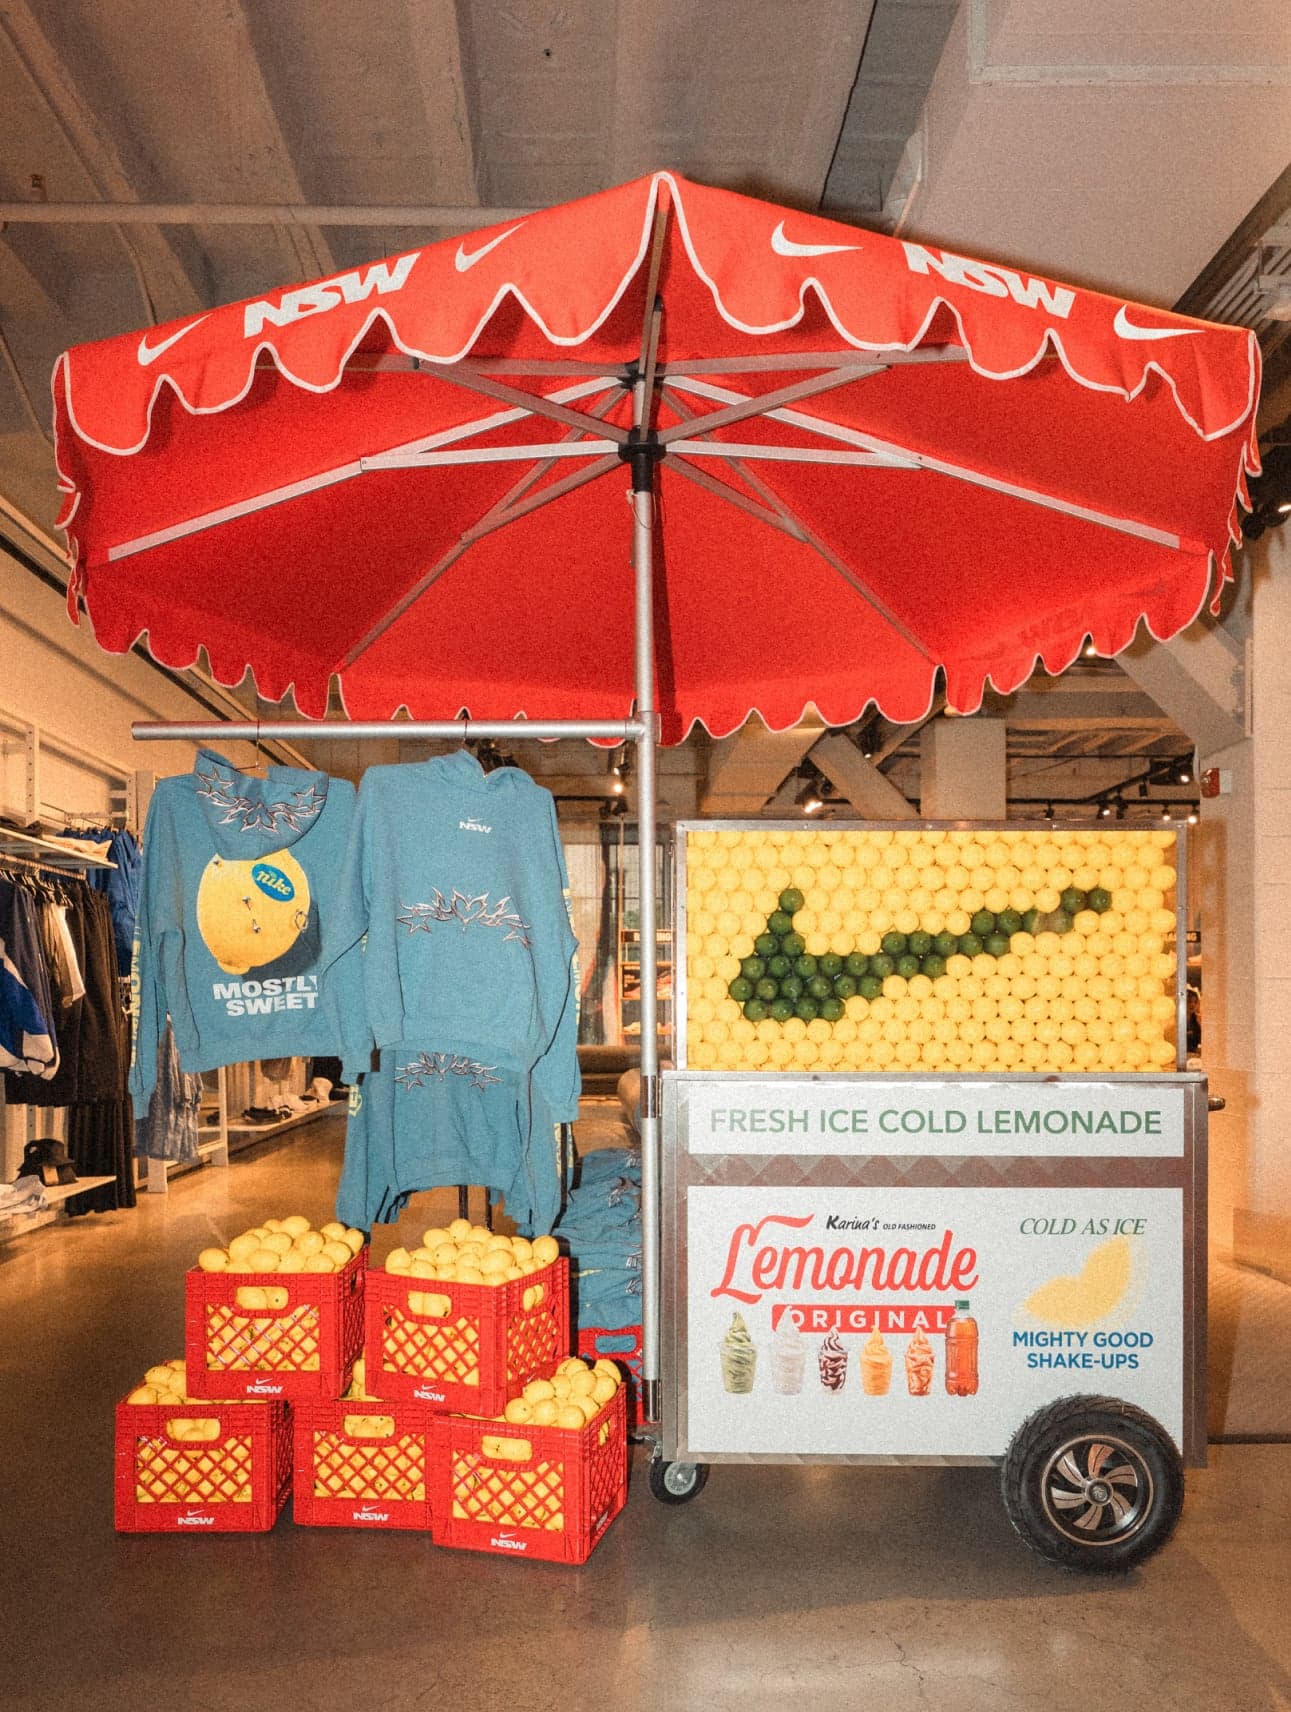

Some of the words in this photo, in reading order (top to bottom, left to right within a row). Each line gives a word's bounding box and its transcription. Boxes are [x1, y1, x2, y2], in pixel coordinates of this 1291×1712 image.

[902, 241, 1077, 320] NSW
[243, 251, 422, 339] NSW
[459, 820, 493, 834] NSW
[226, 992, 319, 1017] SWEET
[710, 1108, 809, 1133] FRESH
[820, 1109, 869, 1133] ICE
[878, 1109, 967, 1134] COLD
[977, 1110, 1163, 1134] LEMONADE
[825, 1214, 880, 1231] Karina's
[882, 1222, 897, 1231] OLD
[897, 1222, 937, 1231] FASHIONED
[1019, 1218, 1077, 1235] COLD
[1081, 1218, 1110, 1235] AS
[1113, 1218, 1148, 1235] ICE
[710, 1213, 980, 1304] Lemonade
[1012, 1331, 1088, 1347] MIGHTY
[1093, 1331, 1154, 1348] GOOD
[1026, 1352, 1140, 1369] SHAKE-UPS
[246, 1385, 284, 1394] NSW
